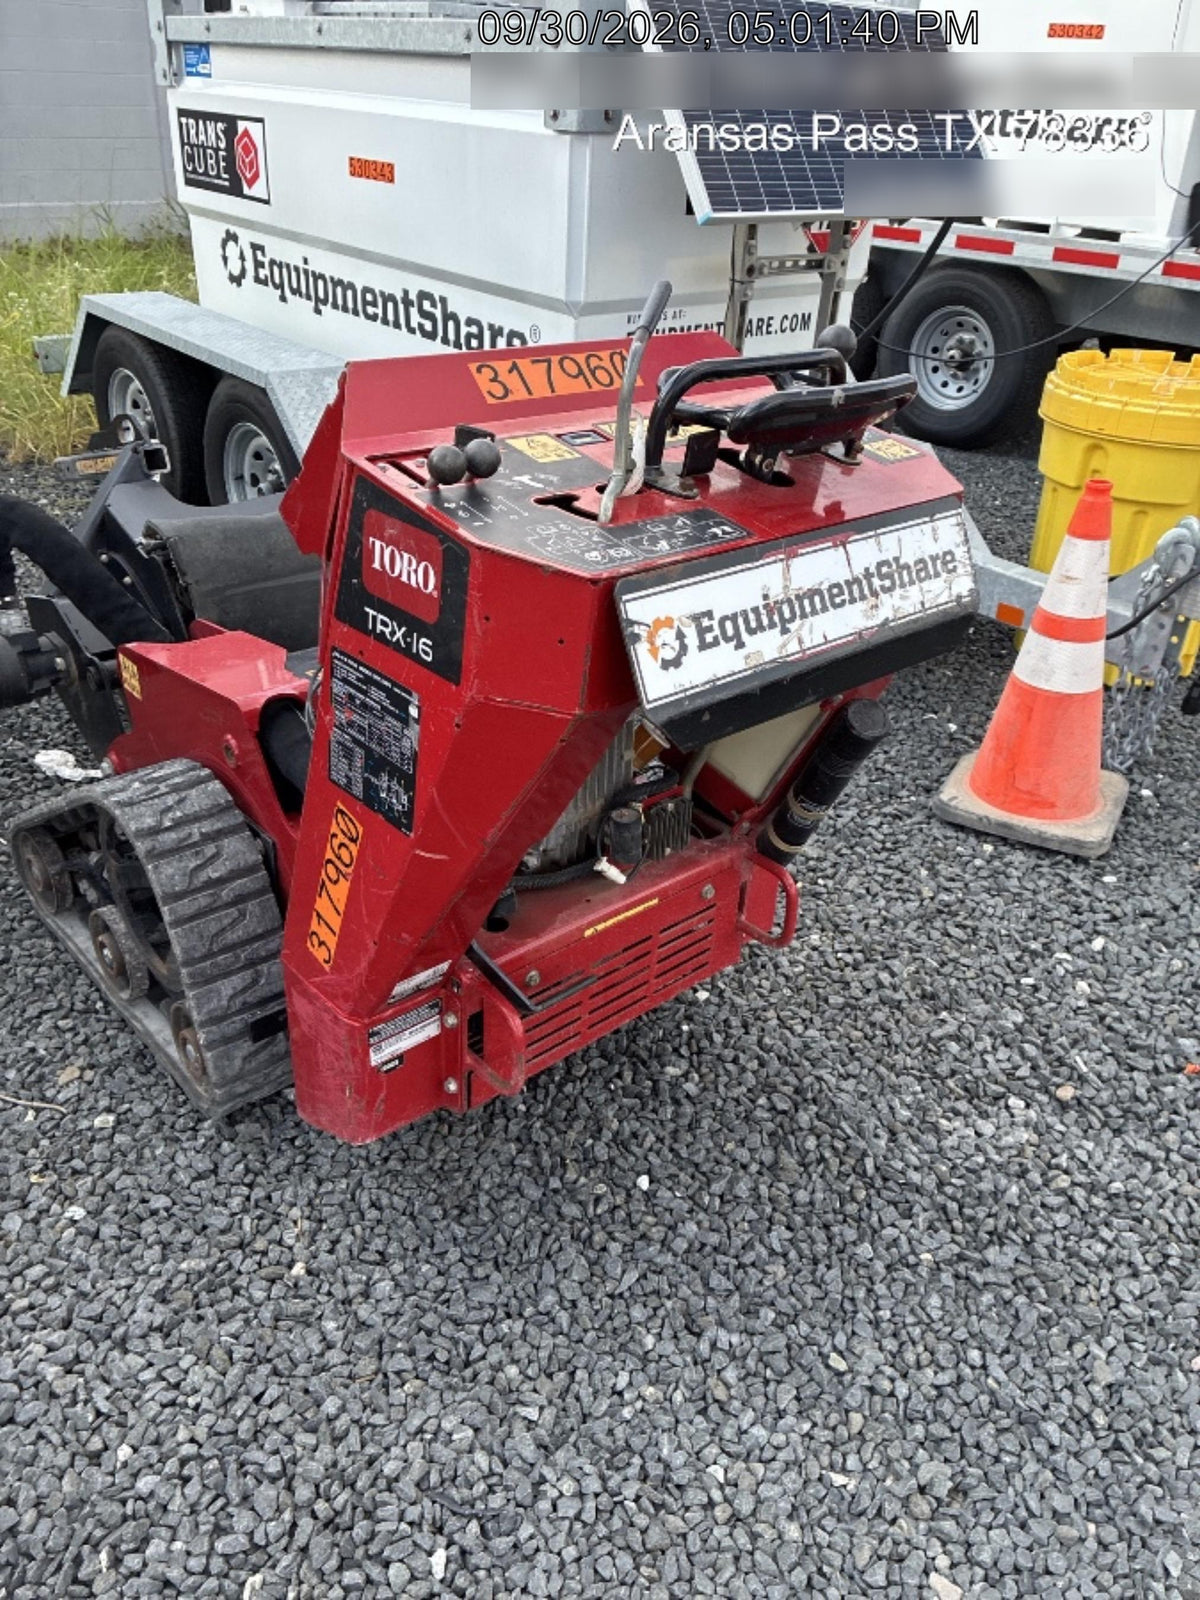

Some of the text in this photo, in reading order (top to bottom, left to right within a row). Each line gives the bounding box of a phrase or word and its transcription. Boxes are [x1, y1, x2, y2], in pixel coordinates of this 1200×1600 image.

[180, 117, 227, 150] TRANS
[184, 145, 230, 178] CUBE
[349, 157, 395, 183] 530343
[368, 537, 436, 595] TORO
[695, 549, 958, 652] EquipmentShare
[363, 606, 434, 662] TRX-16
